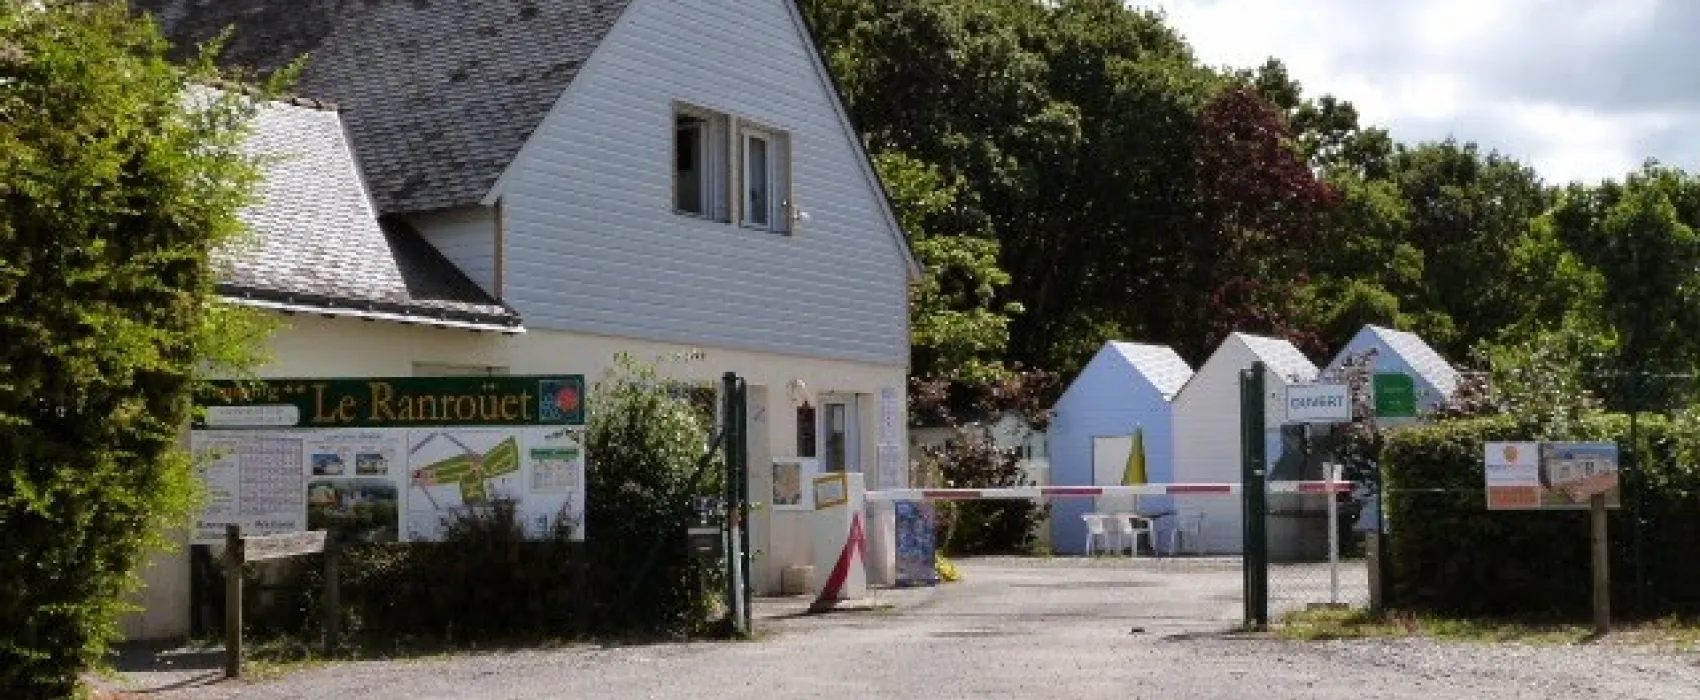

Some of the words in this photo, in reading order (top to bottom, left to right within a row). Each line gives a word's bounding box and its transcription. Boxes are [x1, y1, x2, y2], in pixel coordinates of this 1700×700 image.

[311, 383, 356, 422] Le
[368, 381, 533, 421] Ranroüet
[1290, 395, 1344, 410] OUVERT
